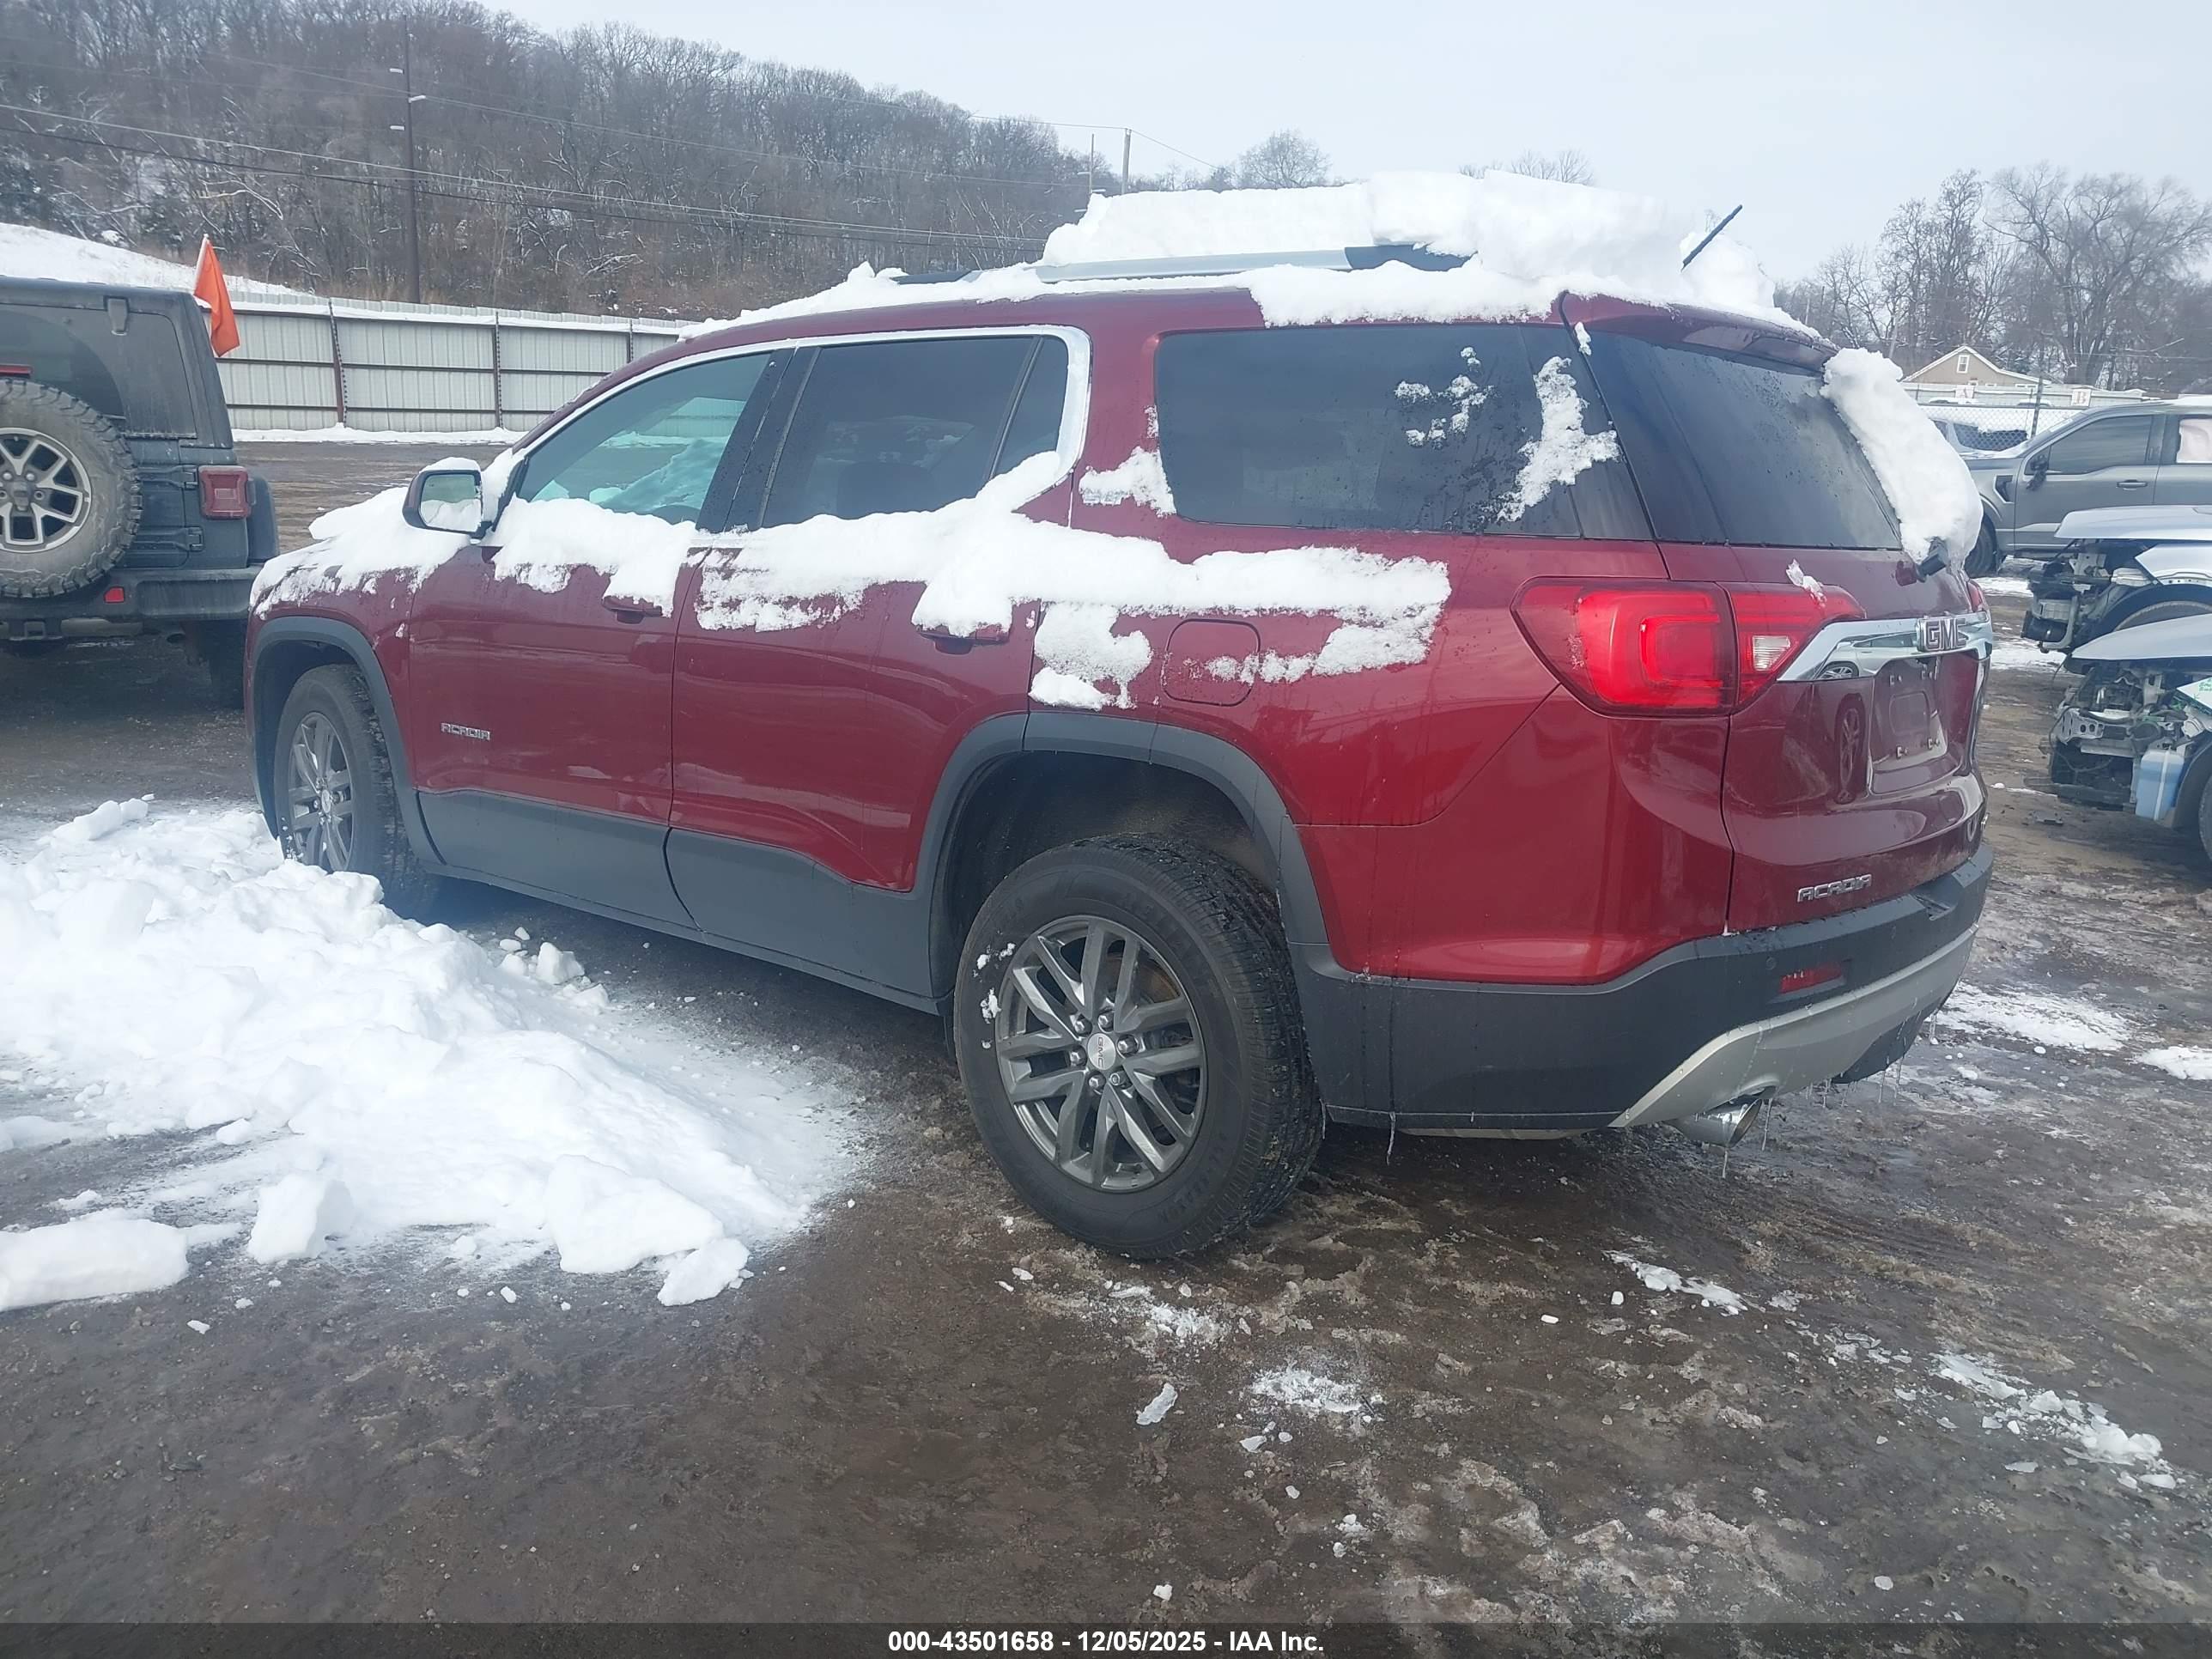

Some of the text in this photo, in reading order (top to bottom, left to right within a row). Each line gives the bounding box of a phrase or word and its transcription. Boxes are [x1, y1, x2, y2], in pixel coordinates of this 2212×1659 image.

[2075, 392, 2087, 405] B
[1923, 617, 1968, 652] GMC
[441, 722, 490, 740] ACADIA
[1797, 874, 1872, 902] ACADIA
